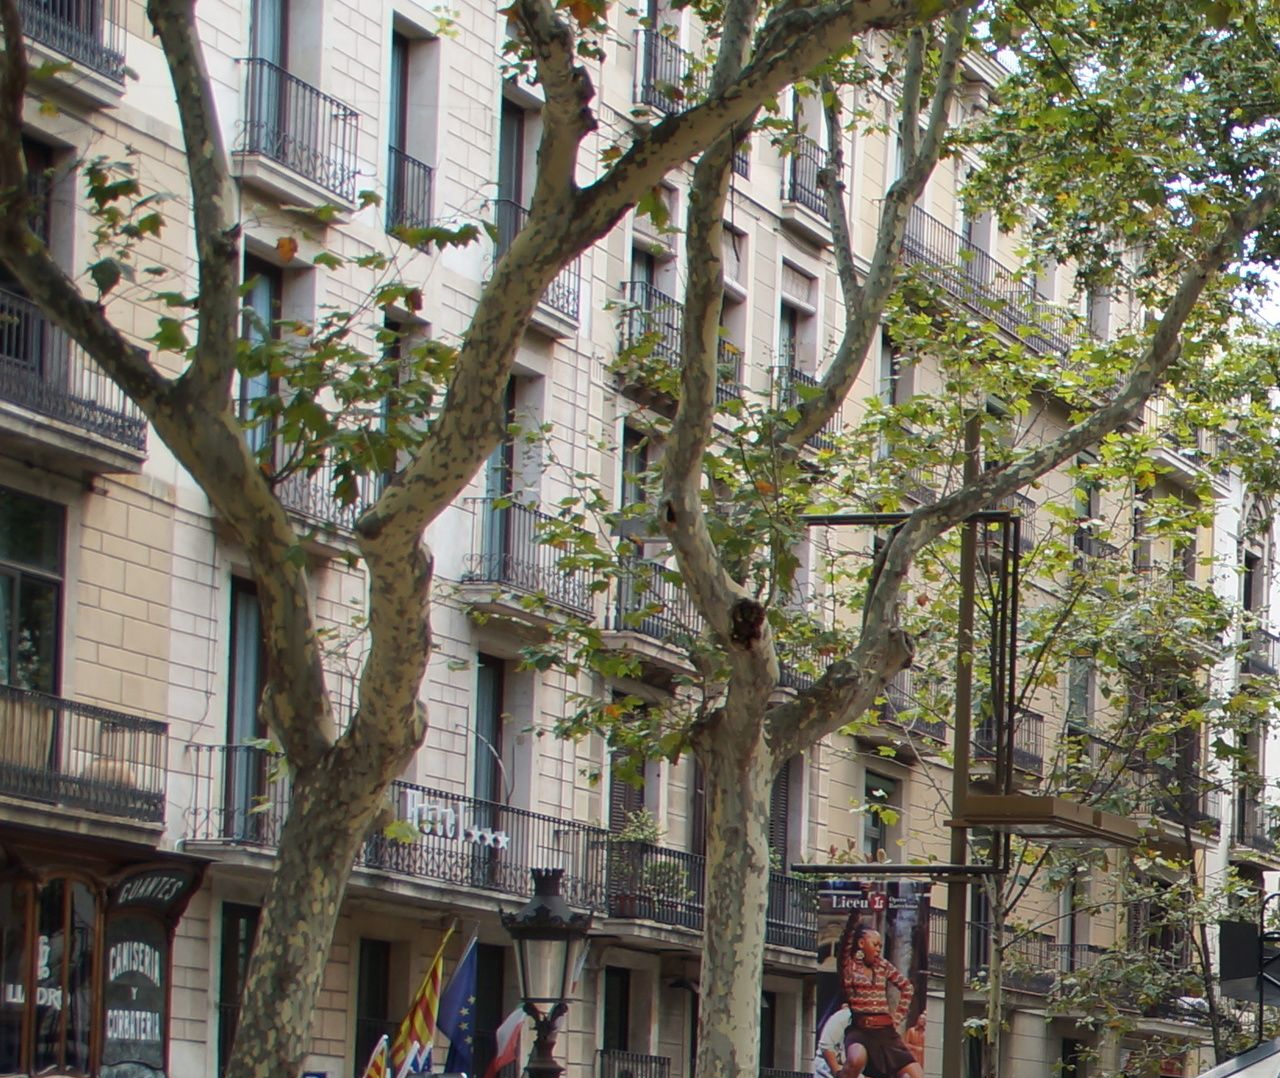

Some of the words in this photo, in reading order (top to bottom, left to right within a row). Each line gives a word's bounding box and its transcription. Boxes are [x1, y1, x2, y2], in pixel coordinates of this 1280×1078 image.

[118, 877, 183, 903] GUANTES
[832, 895, 869, 909] Liceu
[109, 942, 160, 987] CAMISERIA
[131, 987, 138, 1000] Y
[108, 1009, 160, 1041] CORBATERIA
